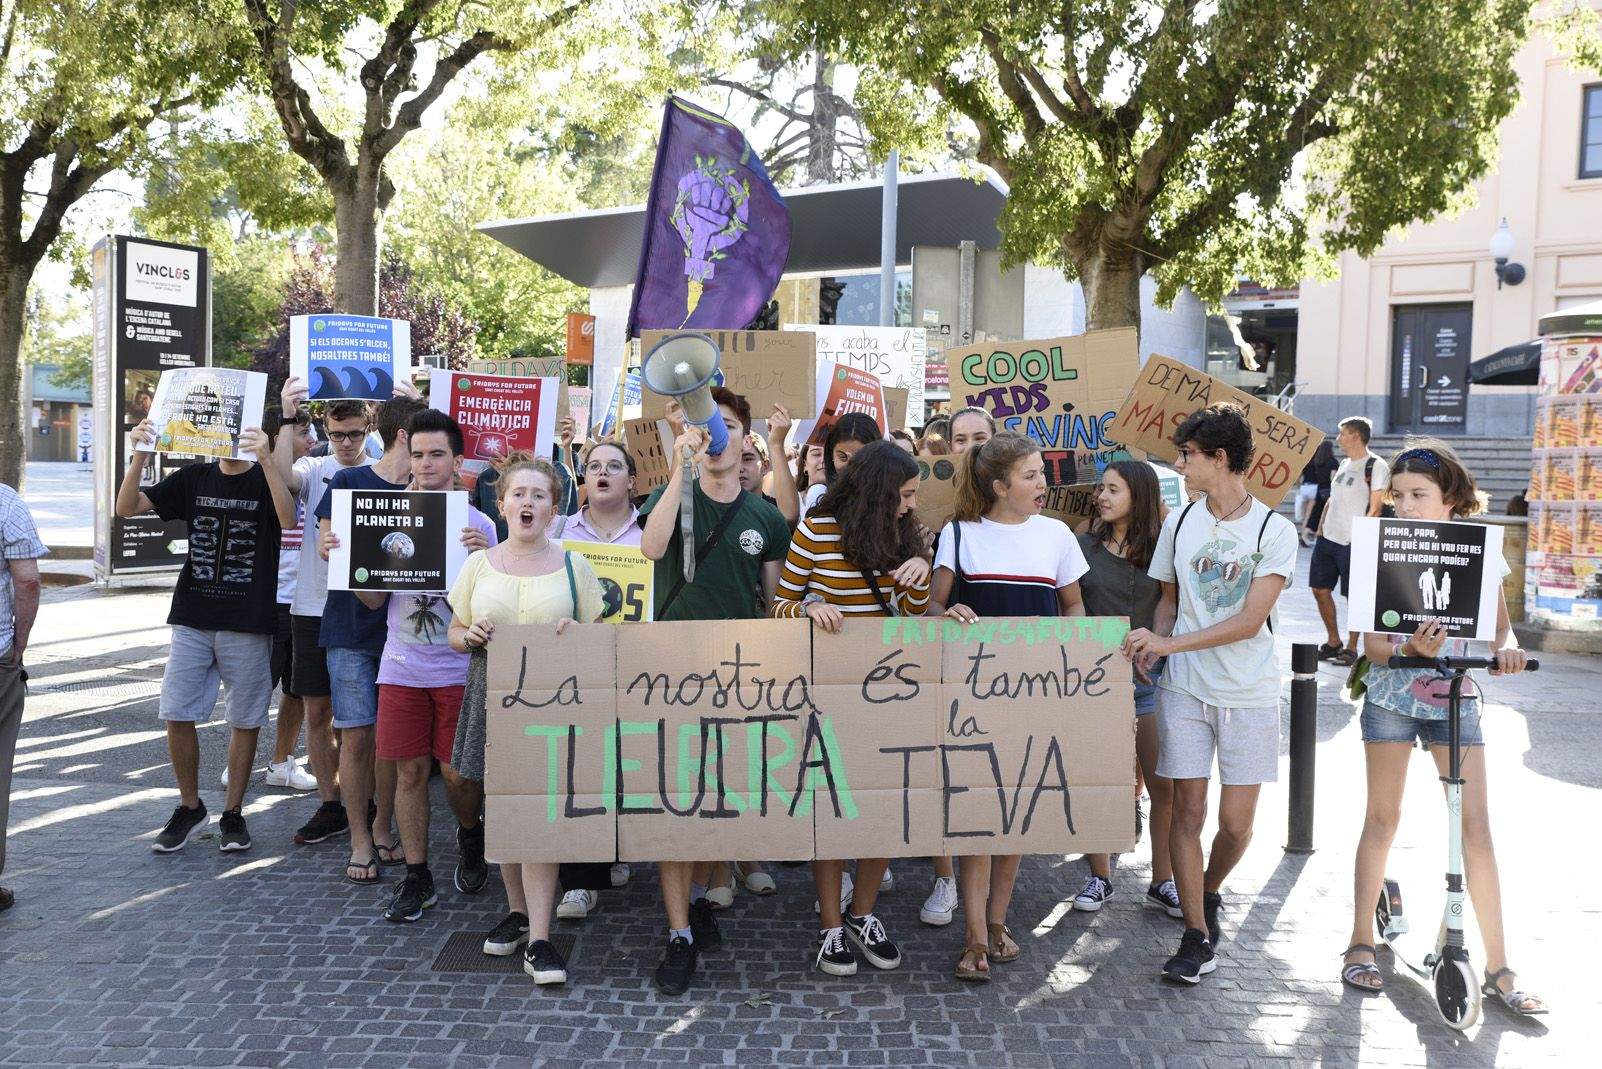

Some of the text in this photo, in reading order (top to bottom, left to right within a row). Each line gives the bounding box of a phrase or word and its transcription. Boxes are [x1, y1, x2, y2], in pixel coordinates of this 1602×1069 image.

[136, 262, 190, 280] VINCL&S
[318, 338, 330, 347] ELS
[331, 338, 360, 347] OCEANS
[843, 329, 879, 350] acaba
[893, 330, 910, 353] el
[311, 351, 391, 363] NOSALTRES TAMBÉ!
[961, 346, 1078, 386] COOL
[459, 395, 532, 412] EMERGÈNCIA
[966, 383, 1051, 419] KIDS
[1148, 363, 1212, 406] DEMÀ
[1256, 416, 1310, 455] SERÀ
[195, 415, 208, 423] HO
[457, 410, 530, 429] CLIMÀTICA
[1077, 451, 1116, 468] PLANET
[356, 498, 410, 511] NO HI HA
[356, 515, 424, 528] PLANETA B
[1384, 527, 1438, 540] MAMA, PAPA,
[1384, 538, 1482, 556] PER QUÈ NO HI VAU FER RES
[624, 558, 648, 566] FUTURE
[1383, 552, 1469, 567] QUAN ENCARA PODÍEU?
[414, 570, 441, 578] FUTURE
[1451, 617, 1474, 625] FUTURE
[502, 642, 1114, 714] La nostra és també
[947, 699, 989, 737] la
[523, 715, 859, 823] TERRA
[880, 735, 1076, 844] TEVA
